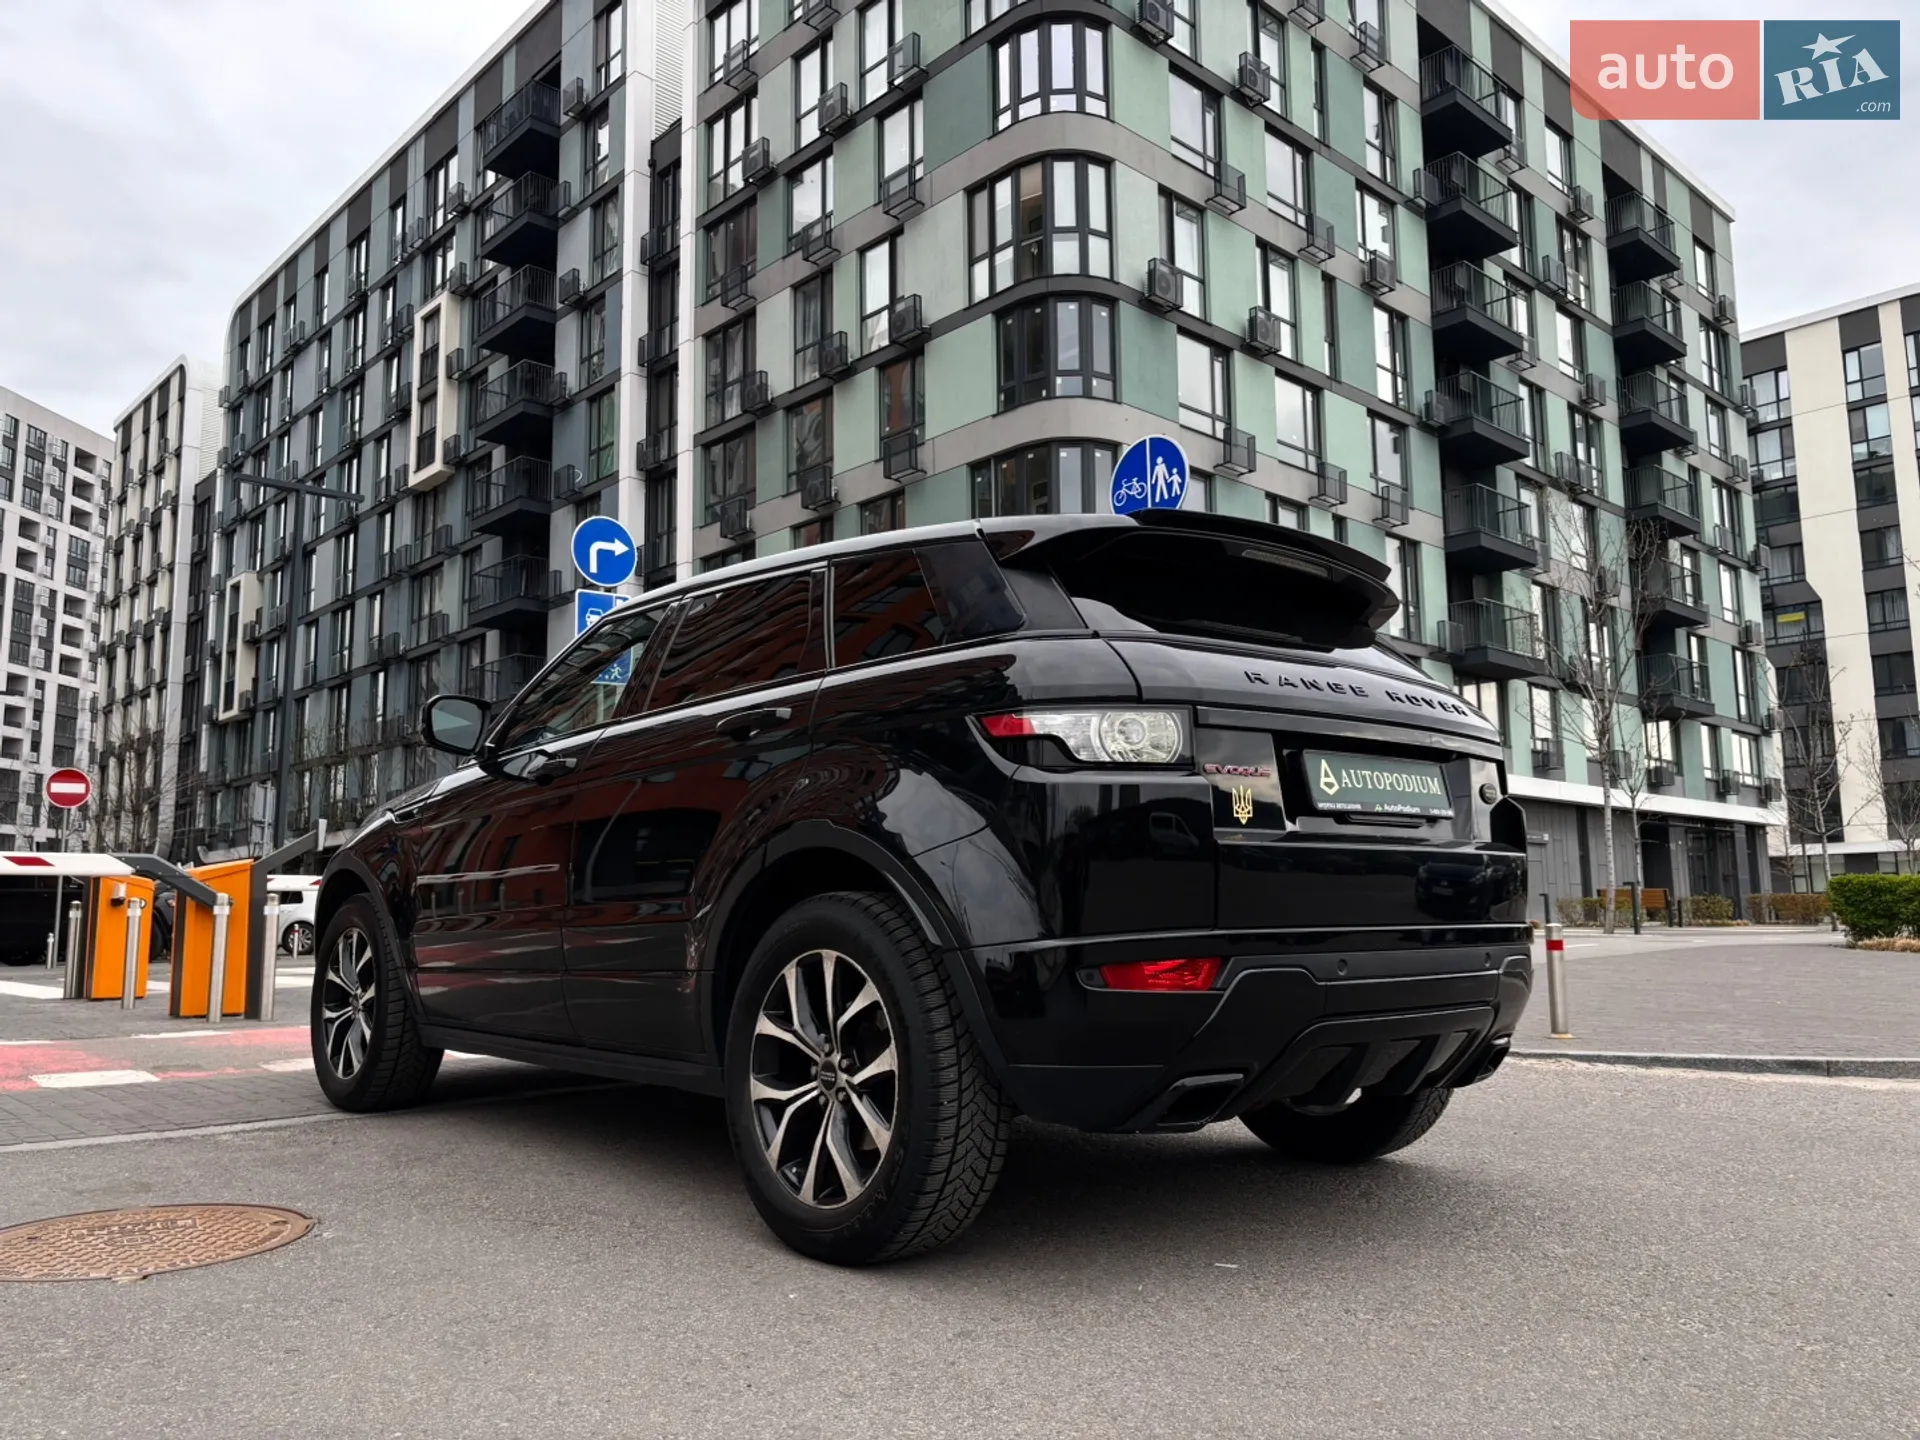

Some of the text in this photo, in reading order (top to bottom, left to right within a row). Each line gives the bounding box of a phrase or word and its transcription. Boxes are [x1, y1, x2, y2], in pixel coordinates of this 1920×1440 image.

[1244, 671, 1468, 717] RANGE ROVER
[1203, 763, 1272, 778] EVOQUE
[1341, 768, 1442, 795] AUTOPODIUM
